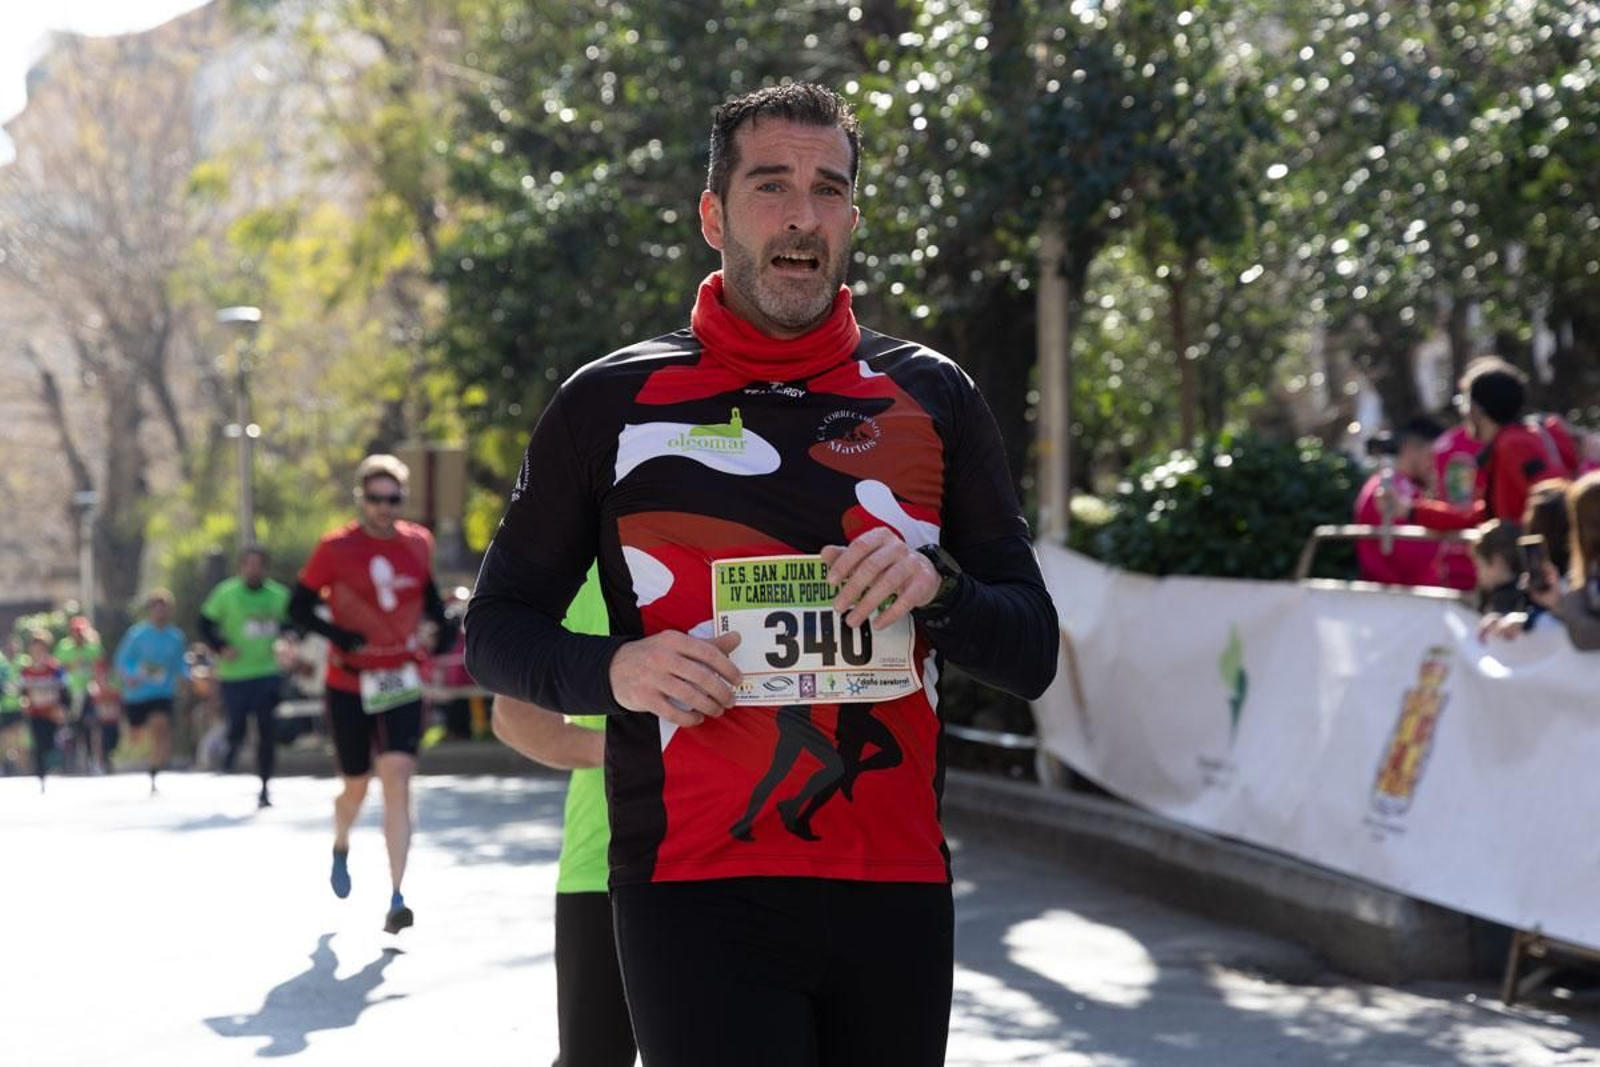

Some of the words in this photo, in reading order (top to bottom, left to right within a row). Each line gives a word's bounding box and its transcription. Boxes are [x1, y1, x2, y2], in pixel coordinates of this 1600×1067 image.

[827, 438, 877, 455] Martos
[753, 564, 777, 582] SAN
[782, 562, 815, 581] JUAN
[730, 586, 741, 602] IV
[746, 583, 795, 603] CARRERA
[764, 610, 873, 669] 340
[879, 676, 910, 686] cerebral
